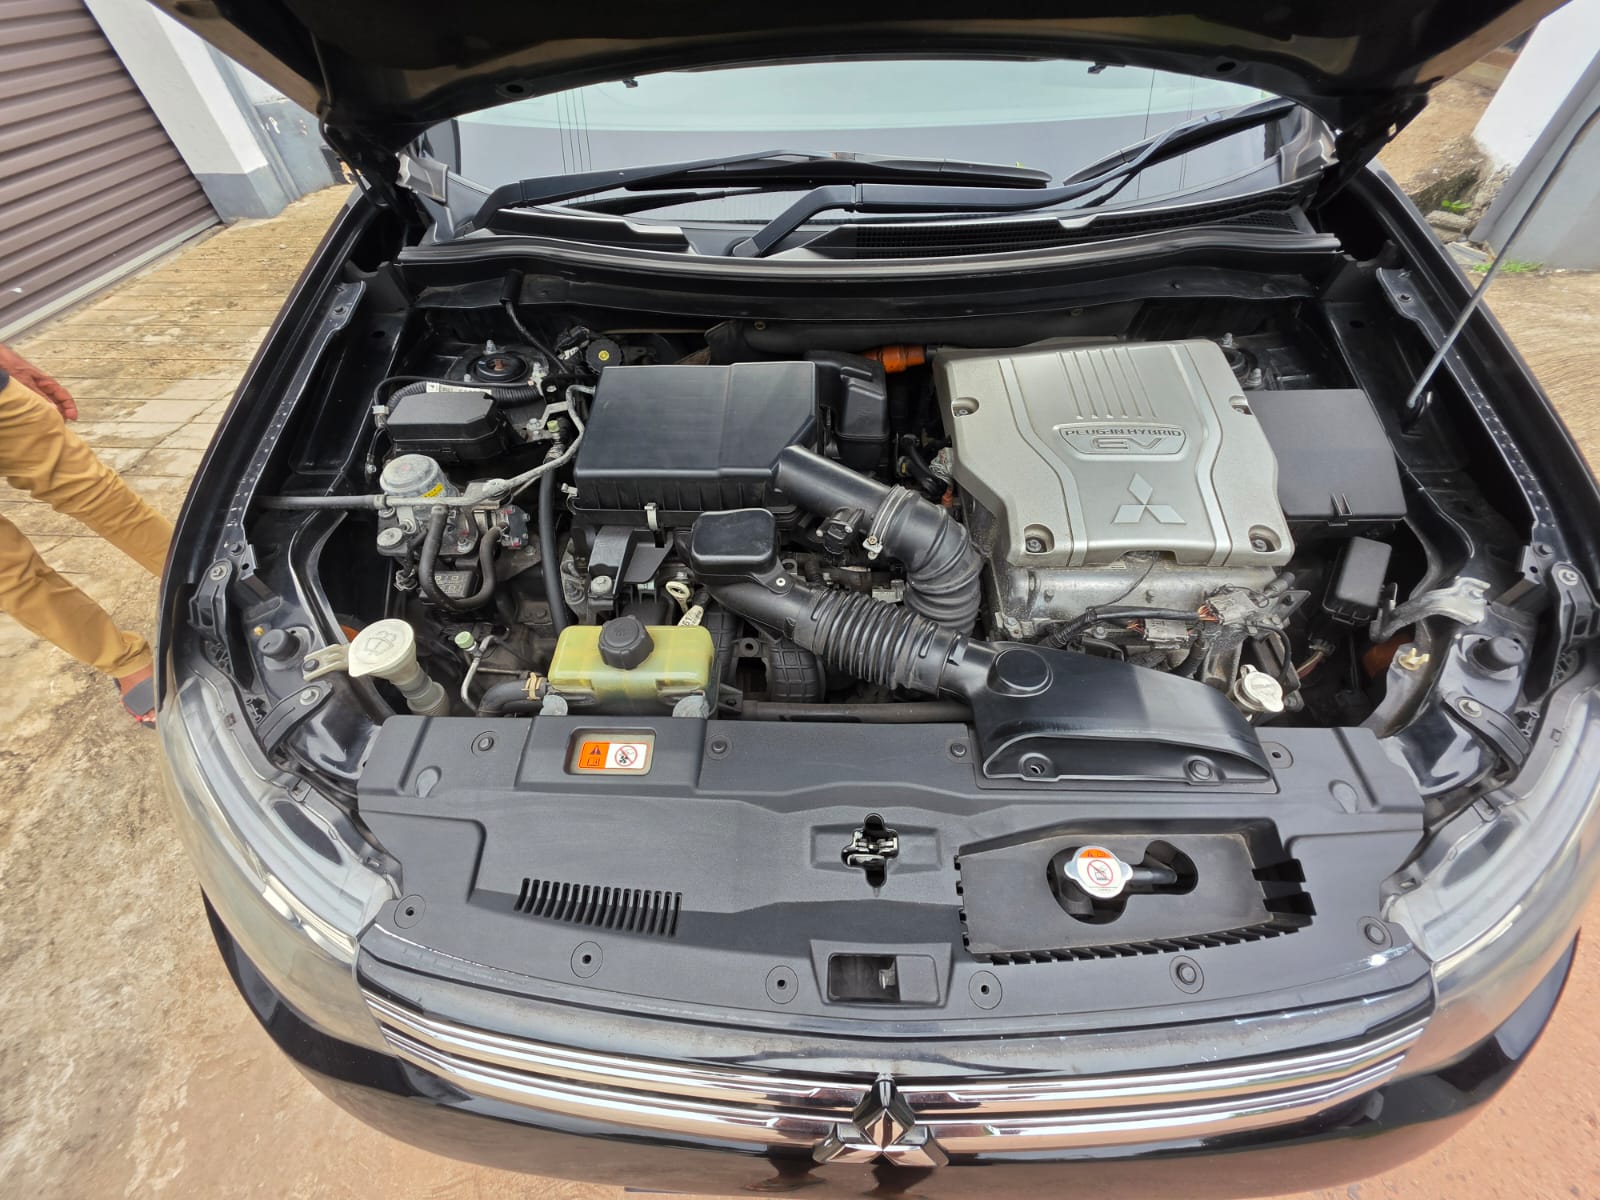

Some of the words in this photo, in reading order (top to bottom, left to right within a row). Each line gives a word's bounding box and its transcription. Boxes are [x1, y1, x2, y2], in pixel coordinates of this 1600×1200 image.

[1065, 428, 1125, 436] PLUG-IN
[1127, 428, 1182, 437] HYBRID
[1091, 437, 1162, 450] EV
